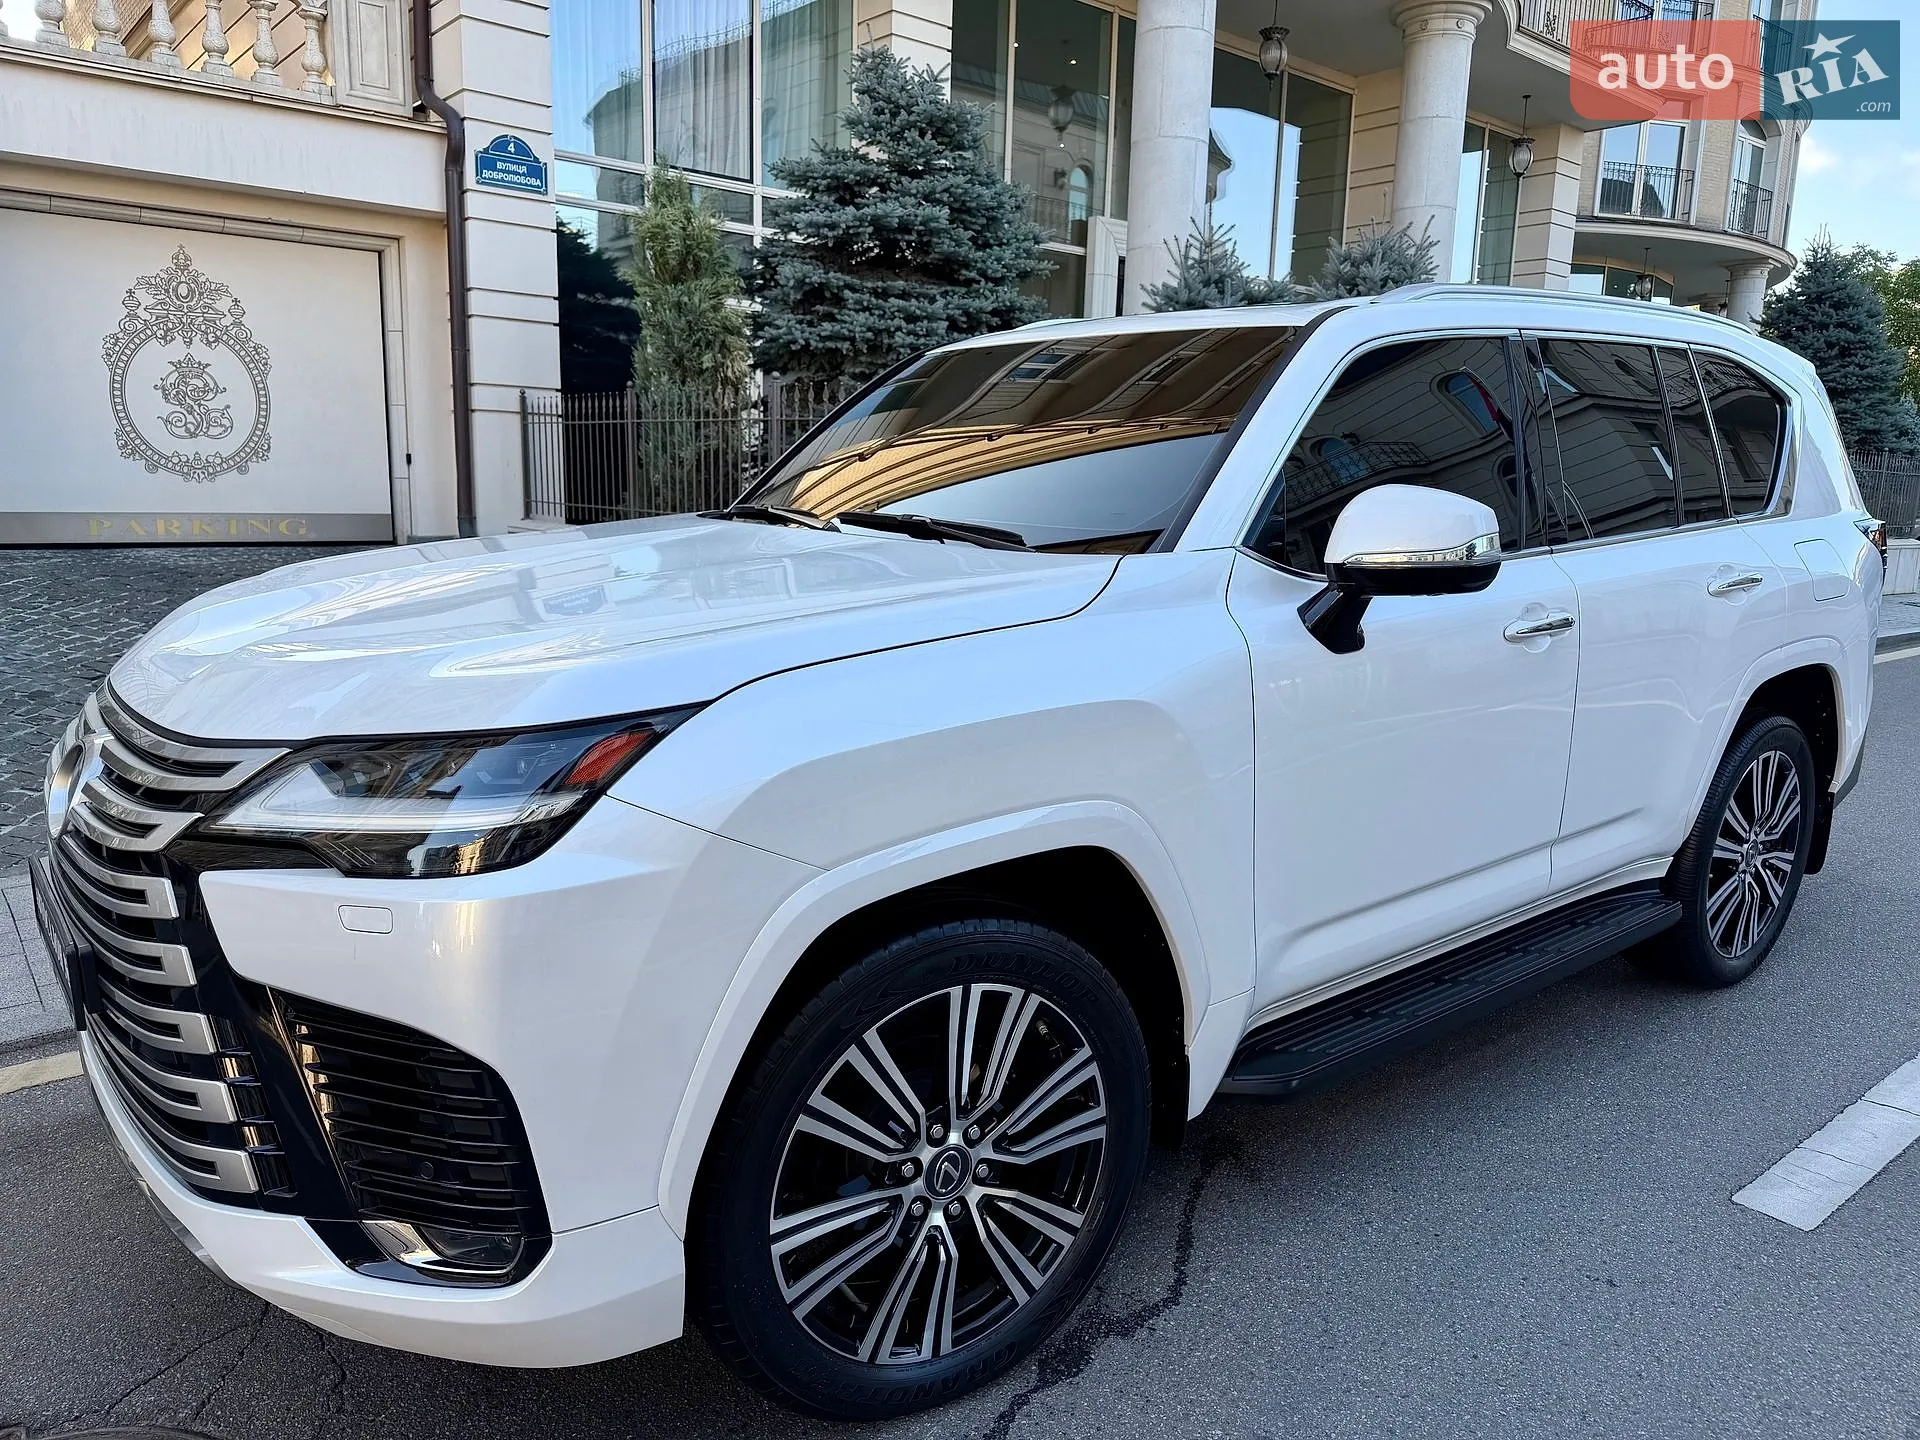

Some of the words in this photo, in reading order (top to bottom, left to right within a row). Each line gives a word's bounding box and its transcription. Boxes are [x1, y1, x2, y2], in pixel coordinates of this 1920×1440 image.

[507, 142, 515, 154] 4
[496, 161, 527, 174] ВУЛИЦЯ
[481, 169, 542, 186] ДОБРОЛЮБОВА
[87, 518, 308, 537] PARKING
[947, 951, 1100, 1003] DUNLOP
